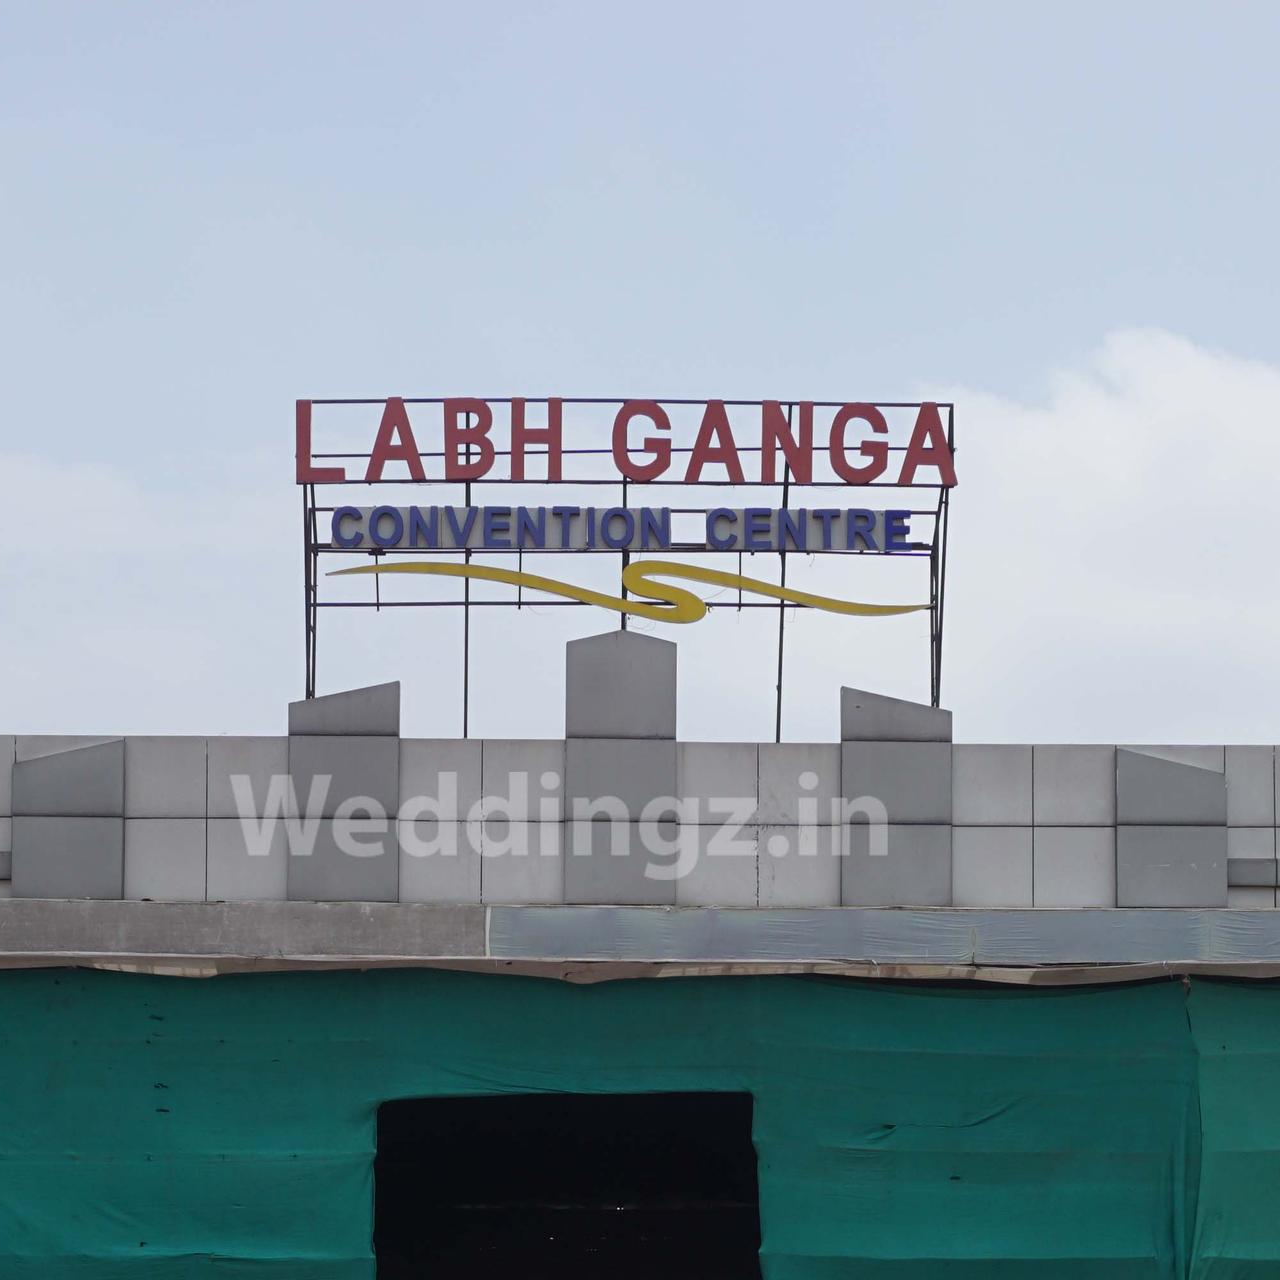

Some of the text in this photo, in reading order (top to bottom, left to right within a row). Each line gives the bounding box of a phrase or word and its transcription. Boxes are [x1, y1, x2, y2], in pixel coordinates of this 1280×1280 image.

[295, 396, 958, 487] LABH GANGA
[329, 505, 913, 552] CONVENTION CENTRE
